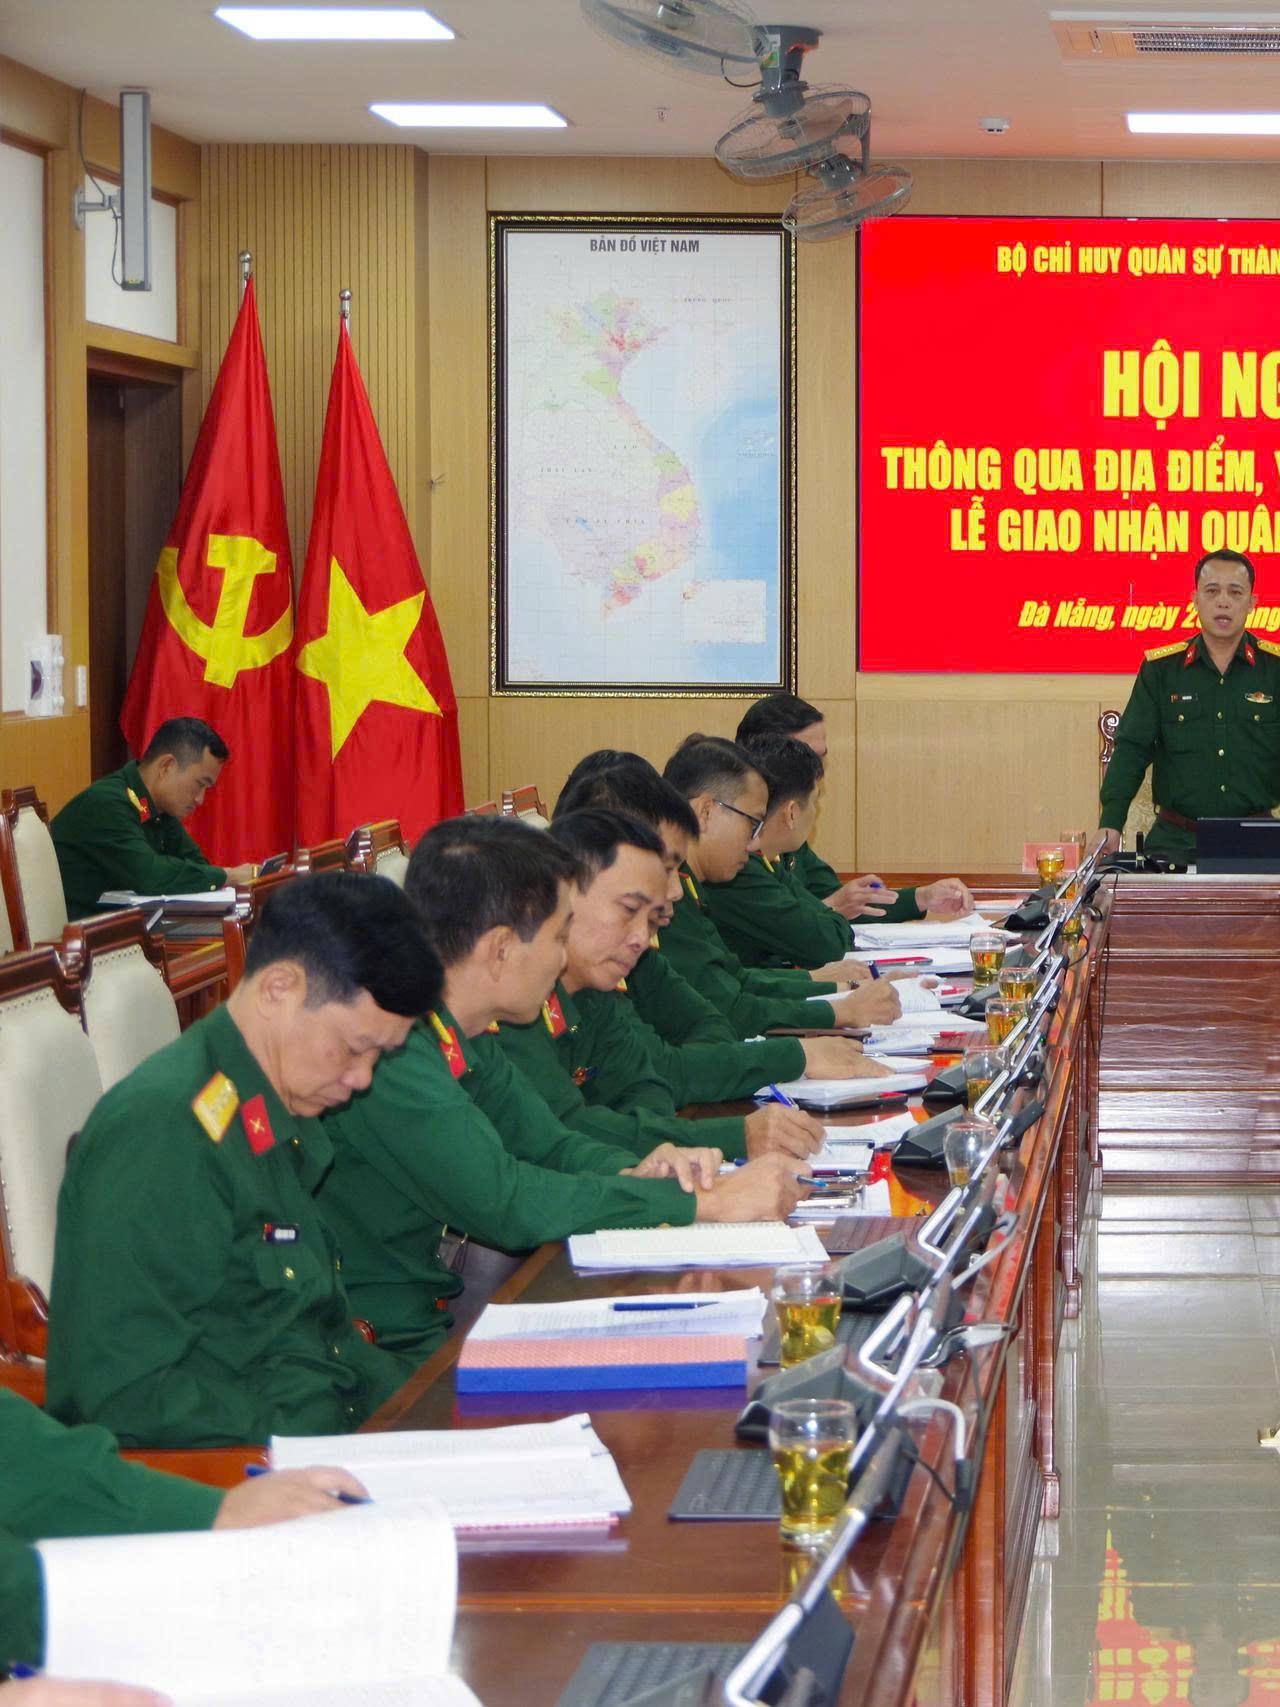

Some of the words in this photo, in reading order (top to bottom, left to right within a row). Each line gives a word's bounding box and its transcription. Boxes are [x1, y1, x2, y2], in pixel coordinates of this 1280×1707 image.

[590, 234, 616, 252] BẢN
[641, 236, 667, 255] VIỆT
[671, 240, 700, 253] NAM
[998, 242, 1026, 276] BỘ
[1034, 241, 1071, 272] CHỈ
[1079, 247, 1121, 273] HUY
[1128, 244, 1186, 276] QUÂN
[1193, 245, 1224, 278] SỰ
[1104, 339, 1199, 430] HỘI
[881, 440, 1001, 490] THÔNG
[1014, 448, 1083, 495] QUA
[1094, 449, 1156, 499] ĐỊA
[1167, 435, 1263, 496] ĐIỂM,
[951, 496, 985, 550] LỄ
[998, 509, 1080, 552] GIAO
[1094, 503, 1188, 560] NHẬN
[1018, 601, 1050, 627] Đà
[1054, 598, 1114, 630] Nẵng,
[1121, 602, 1180, 630] ngày
[1181, 602, 1202, 628] 2
